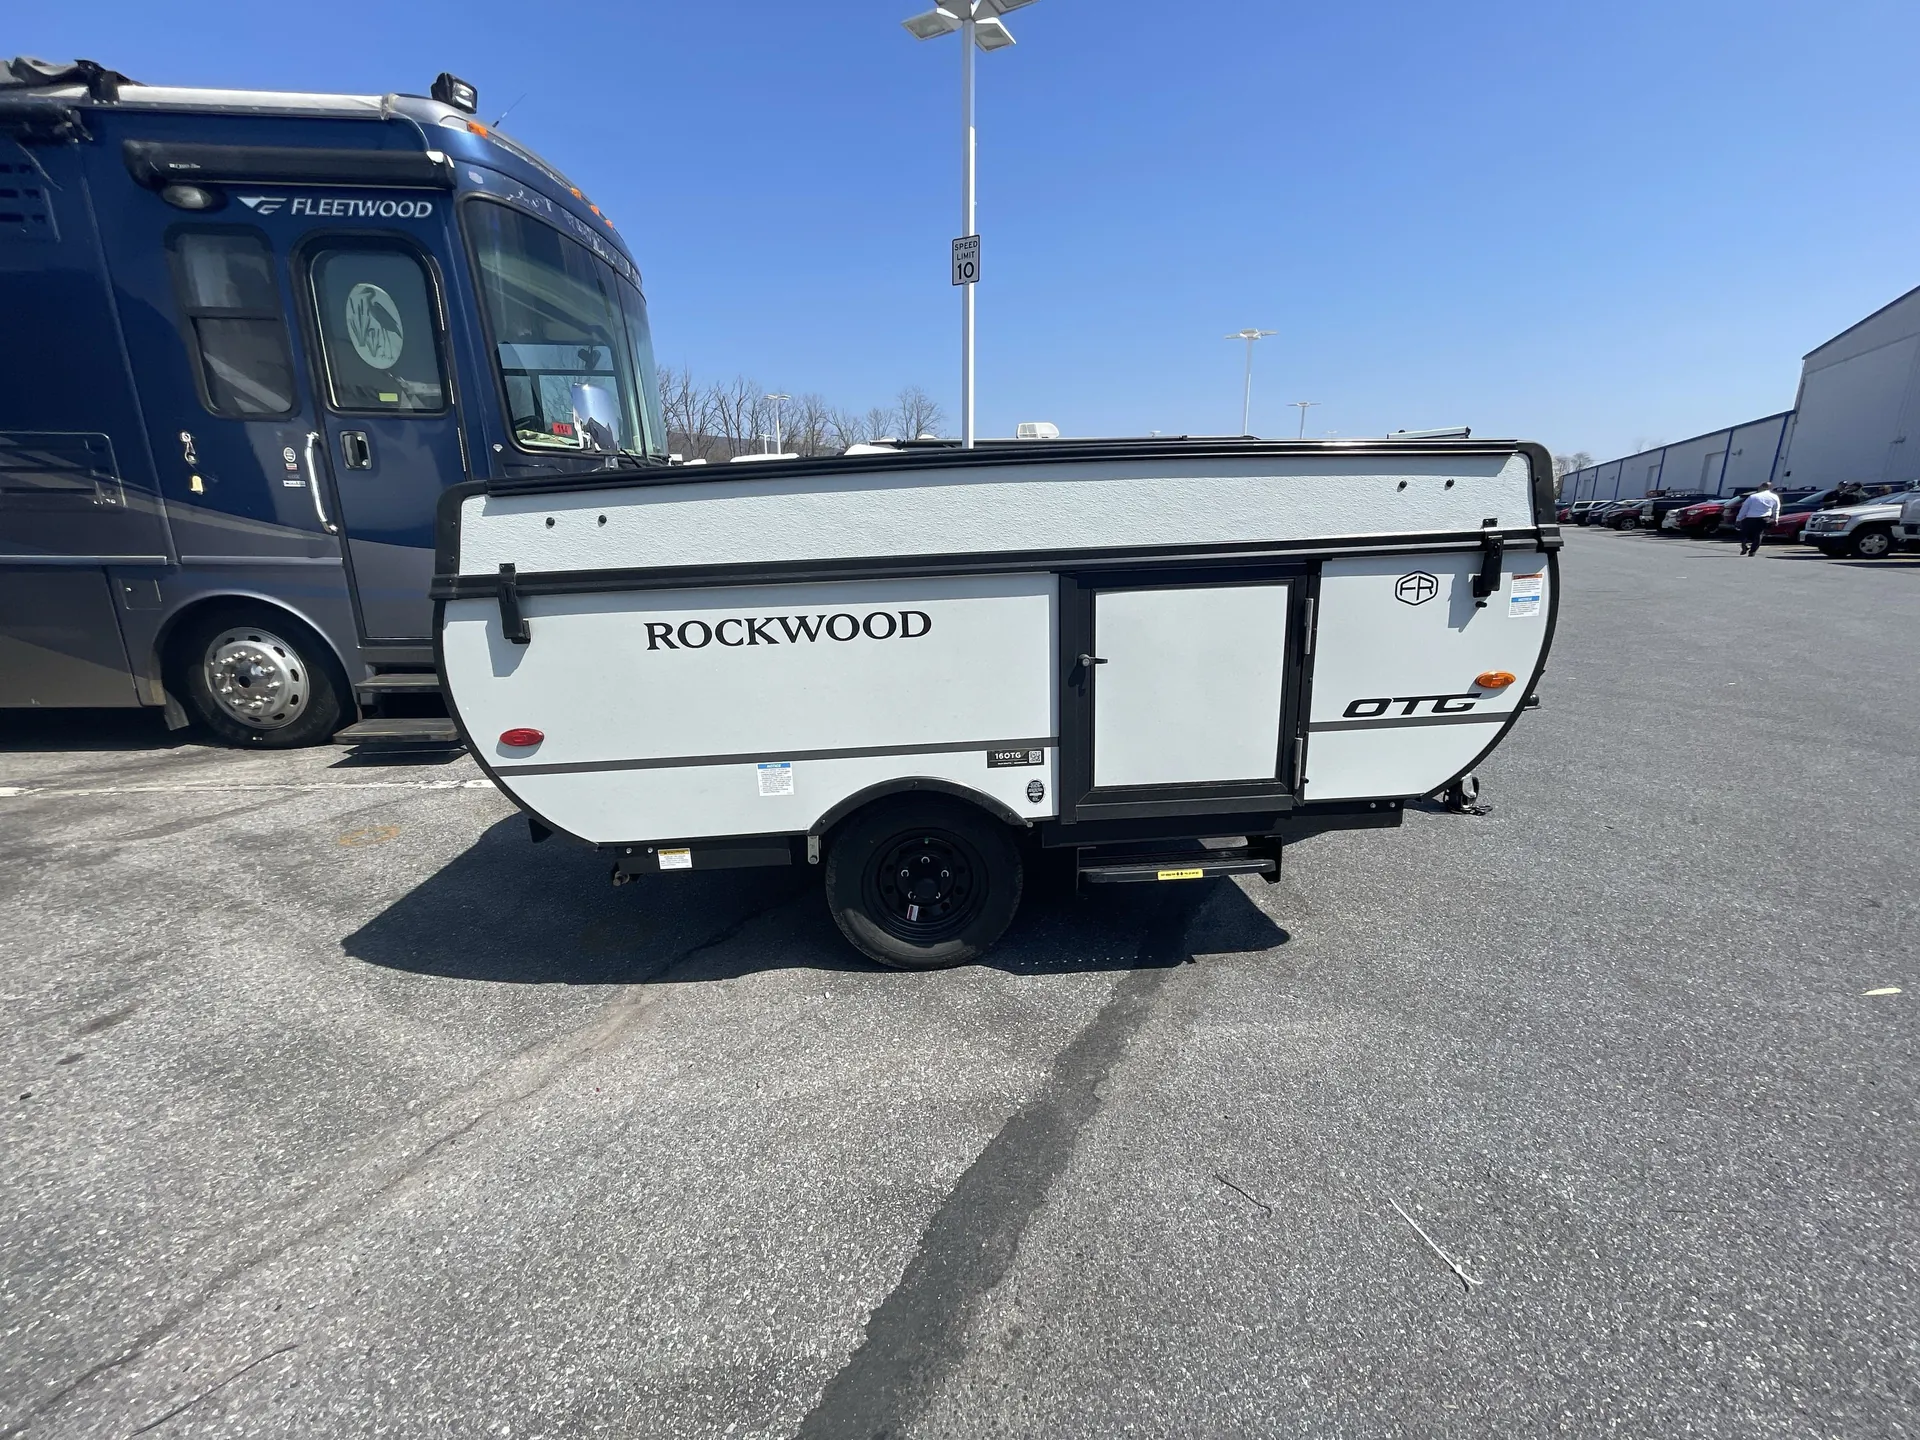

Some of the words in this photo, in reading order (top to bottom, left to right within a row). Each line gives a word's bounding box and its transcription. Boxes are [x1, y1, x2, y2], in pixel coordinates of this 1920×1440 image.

[291, 198, 433, 218] FLEETWOOD
[954, 240, 978, 251] SPEED
[956, 251, 975, 261] LIMIT
[957, 261, 975, 280] 10
[643, 610, 932, 650] ROCKWOOD
[1342, 692, 1482, 718] OTG
